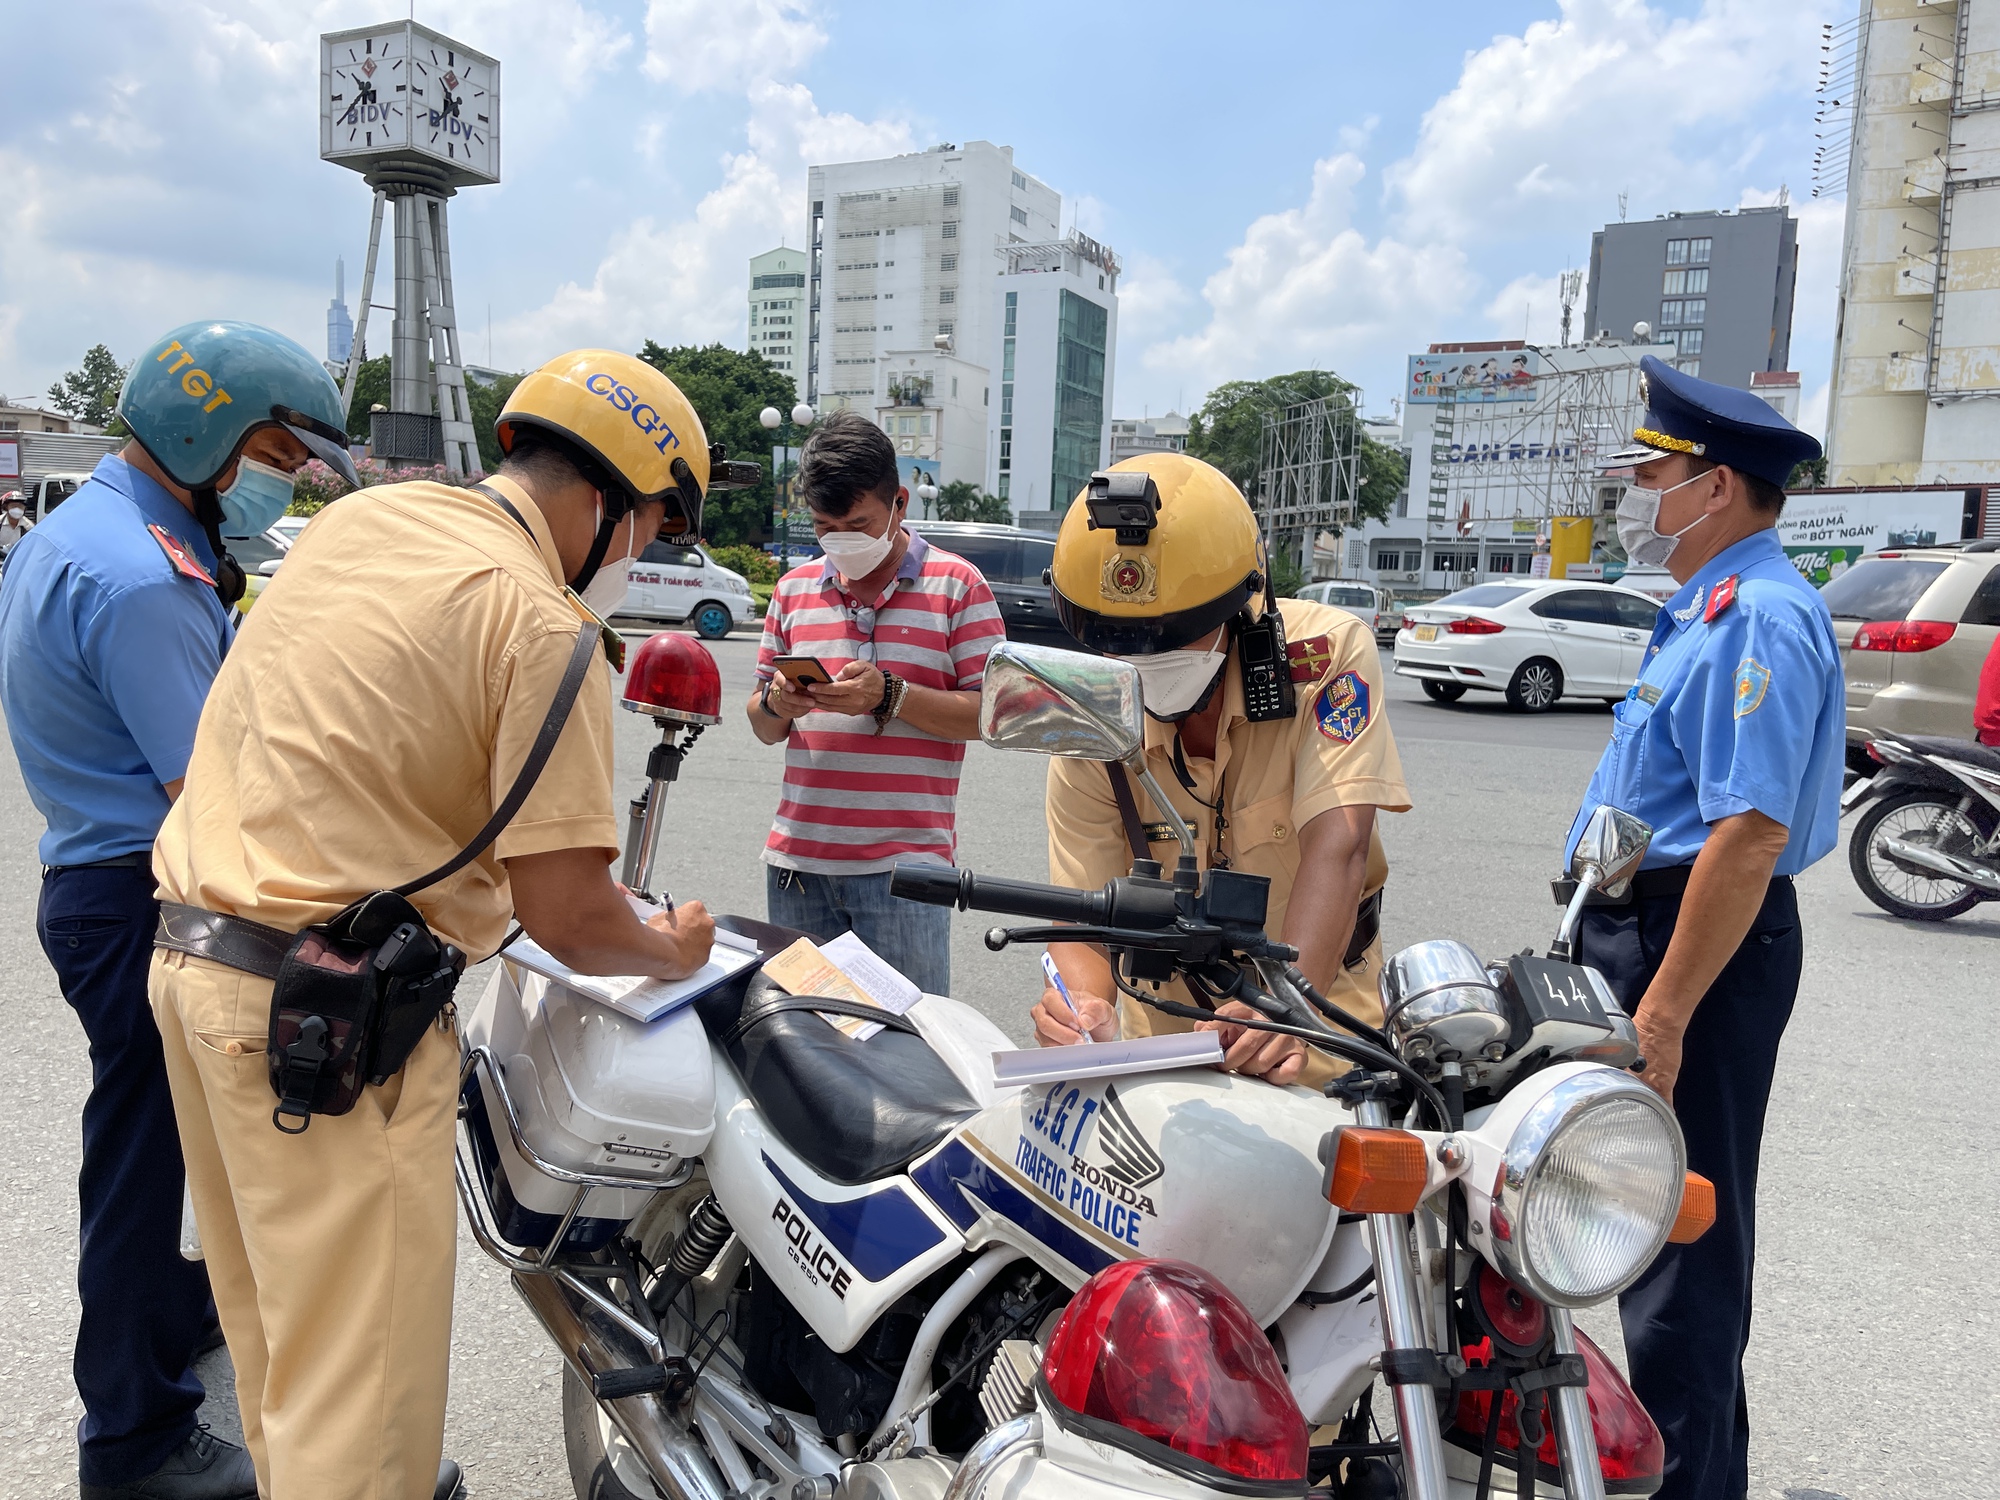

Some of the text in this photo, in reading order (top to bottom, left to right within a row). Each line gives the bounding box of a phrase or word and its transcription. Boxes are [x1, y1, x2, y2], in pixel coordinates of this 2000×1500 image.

[347, 103, 391, 125] BIDV
[429, 108, 473, 140] BIDV
[157, 341, 233, 413] TTGT
[586, 374, 680, 455] CSGT
[1792, 533, 1807, 541] CHO
[1810, 528, 1834, 541] BỚT
[1800, 518, 1824, 530] RAU
[1826, 513, 1844, 526] MÁ
[663, 576, 683, 586] TOÀN
[684, 577, 703, 588] QUỐC
[1543, 972, 1590, 1013] 44
[1015, 1134, 1142, 1248] TRAFFIC POLICE
[1071, 1155, 1157, 1217] HONDA
[772, 1197, 853, 1301] POLICE
[788, 1246, 818, 1286] CB 250
